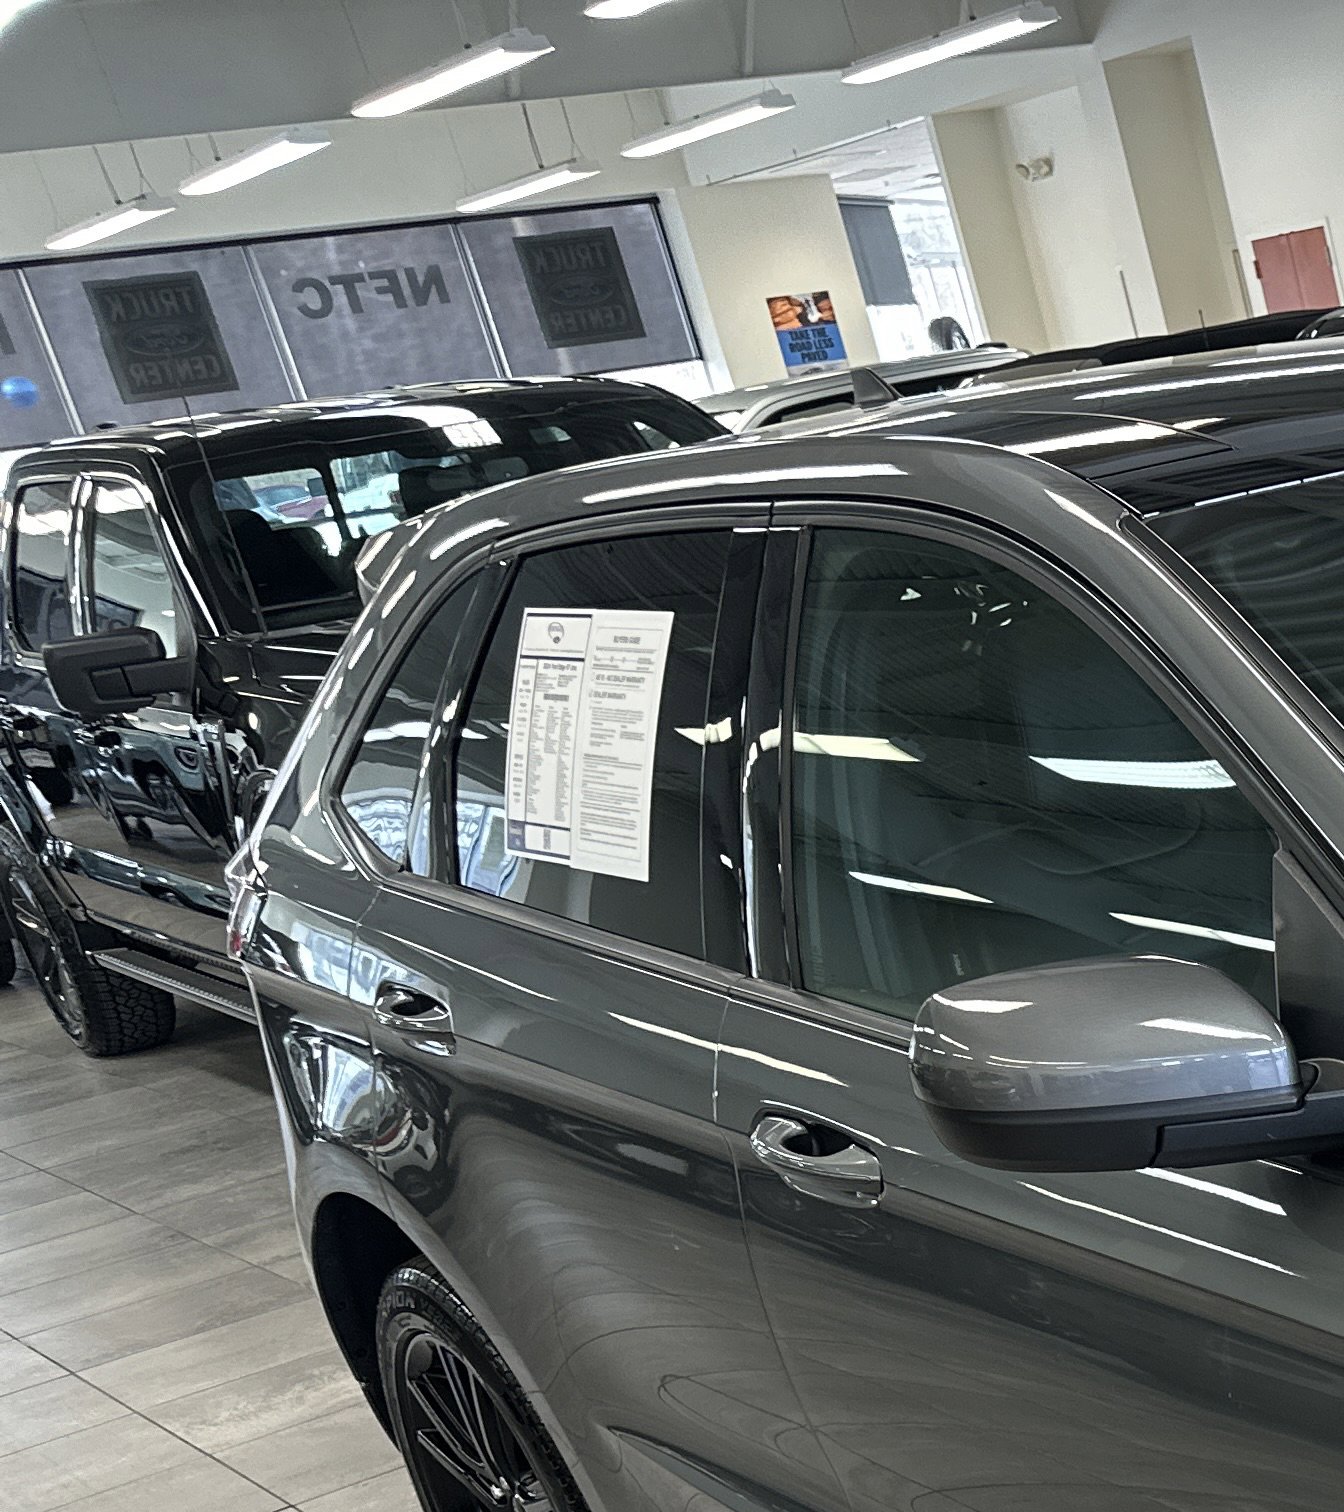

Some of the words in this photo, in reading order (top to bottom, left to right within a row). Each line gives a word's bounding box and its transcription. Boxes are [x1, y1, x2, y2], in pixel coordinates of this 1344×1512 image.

[788, 330, 810, 341] TAKE
[788, 341, 813, 353] ROAD
[814, 338, 835, 349] LESS
